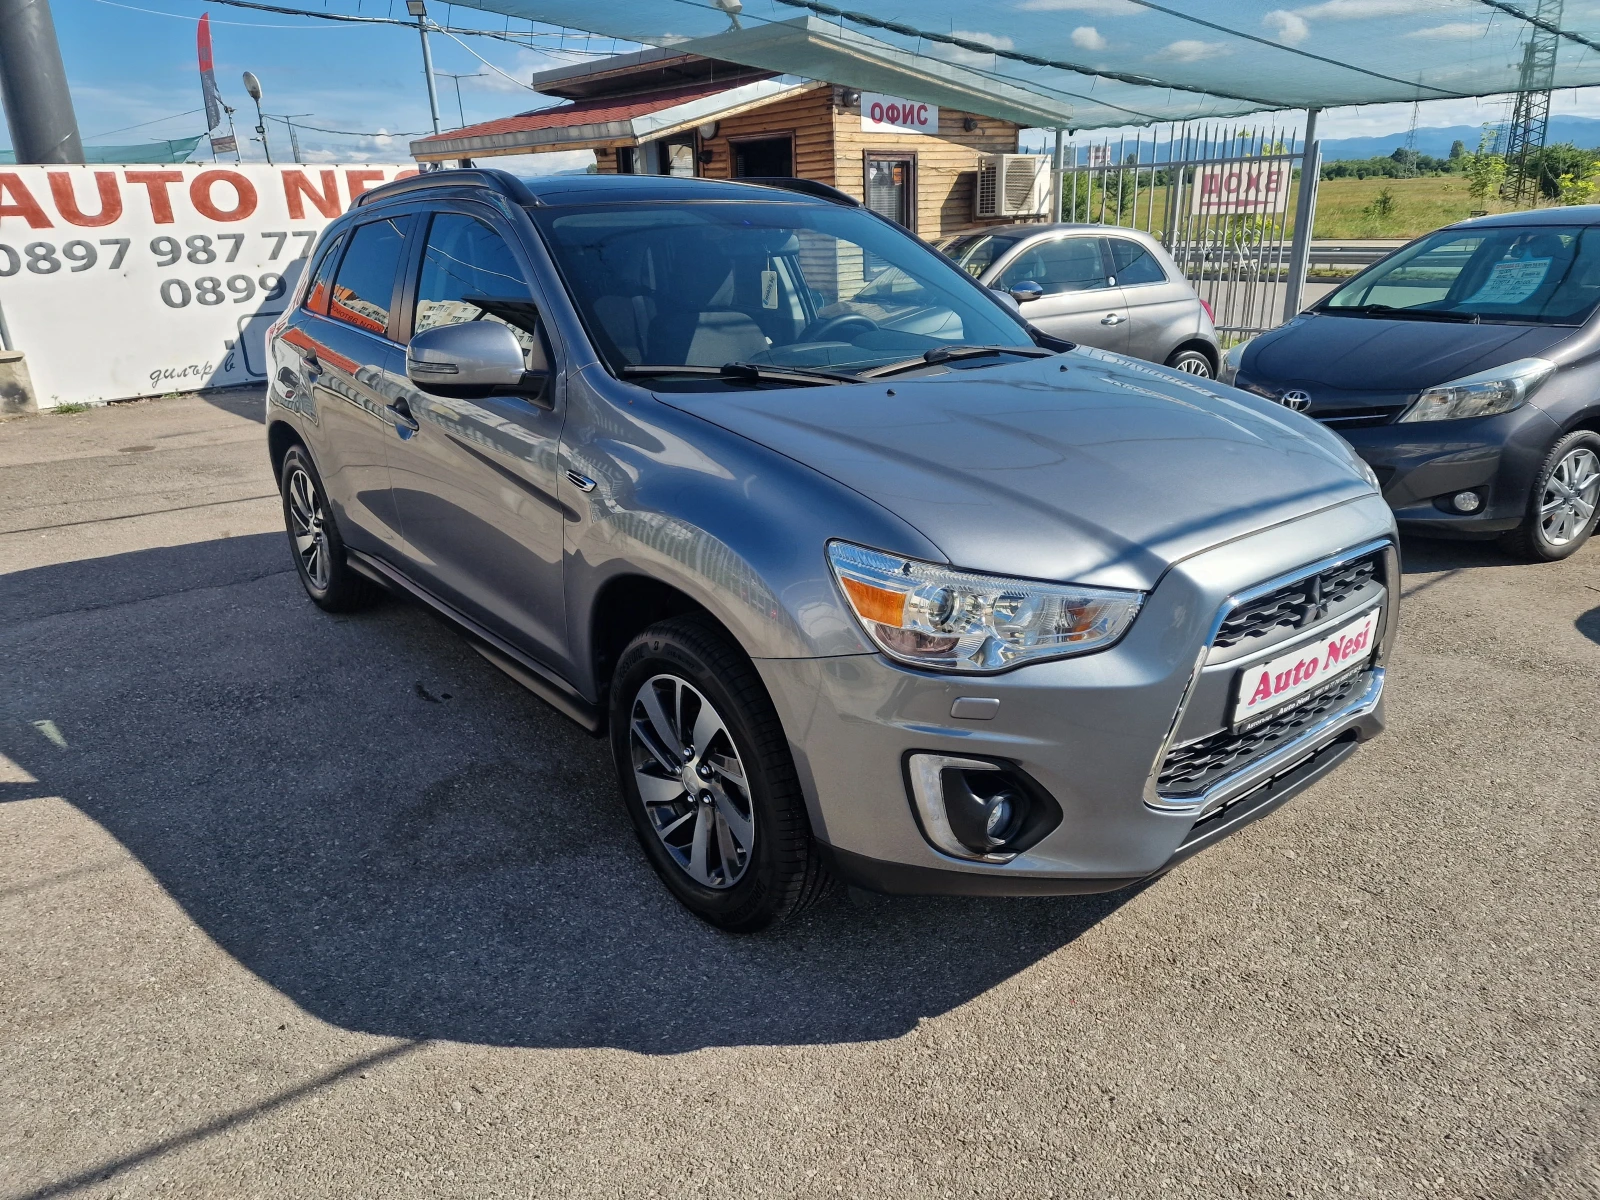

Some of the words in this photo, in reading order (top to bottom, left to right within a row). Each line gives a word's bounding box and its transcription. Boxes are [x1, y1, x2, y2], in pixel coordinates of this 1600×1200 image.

[870, 102, 929, 126] ОФИС
[0, 169, 258, 229] AUTO
[0, 238, 131, 277] 0897
[149, 232, 245, 268] 987
[160, 271, 287, 309] 0899
[149, 360, 214, 389] дилър
[1247, 656, 1319, 706] Auto
[1323, 620, 1371, 671] Nesi
